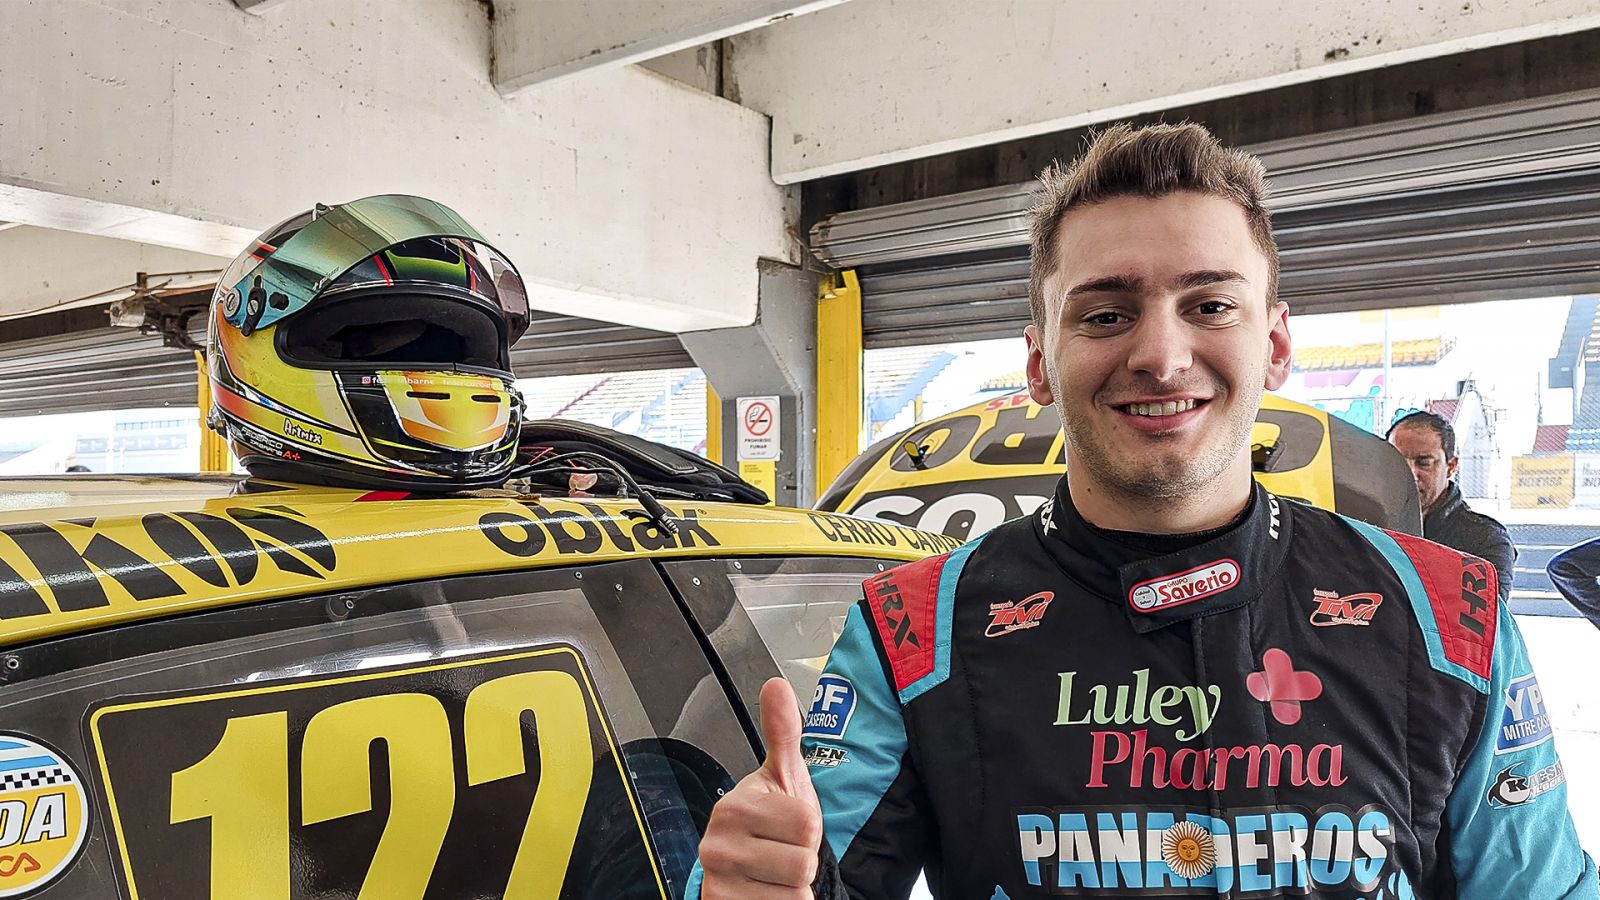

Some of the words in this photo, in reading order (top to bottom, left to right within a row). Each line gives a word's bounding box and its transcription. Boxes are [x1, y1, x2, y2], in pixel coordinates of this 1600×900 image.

[283, 418, 323, 445] Artmix
[478, 502, 720, 558] oblak
[807, 512, 897, 547] CERRO
[873, 571, 923, 650] HRX
[1158, 570, 1232, 603] Saverio
[1053, 668, 1221, 742] Luley
[1503, 718, 1538, 741] MITRE
[170, 670, 594, 900] 122
[1085, 730, 1348, 792] Pharma
[1016, 811, 1391, 894] PANADEROS
